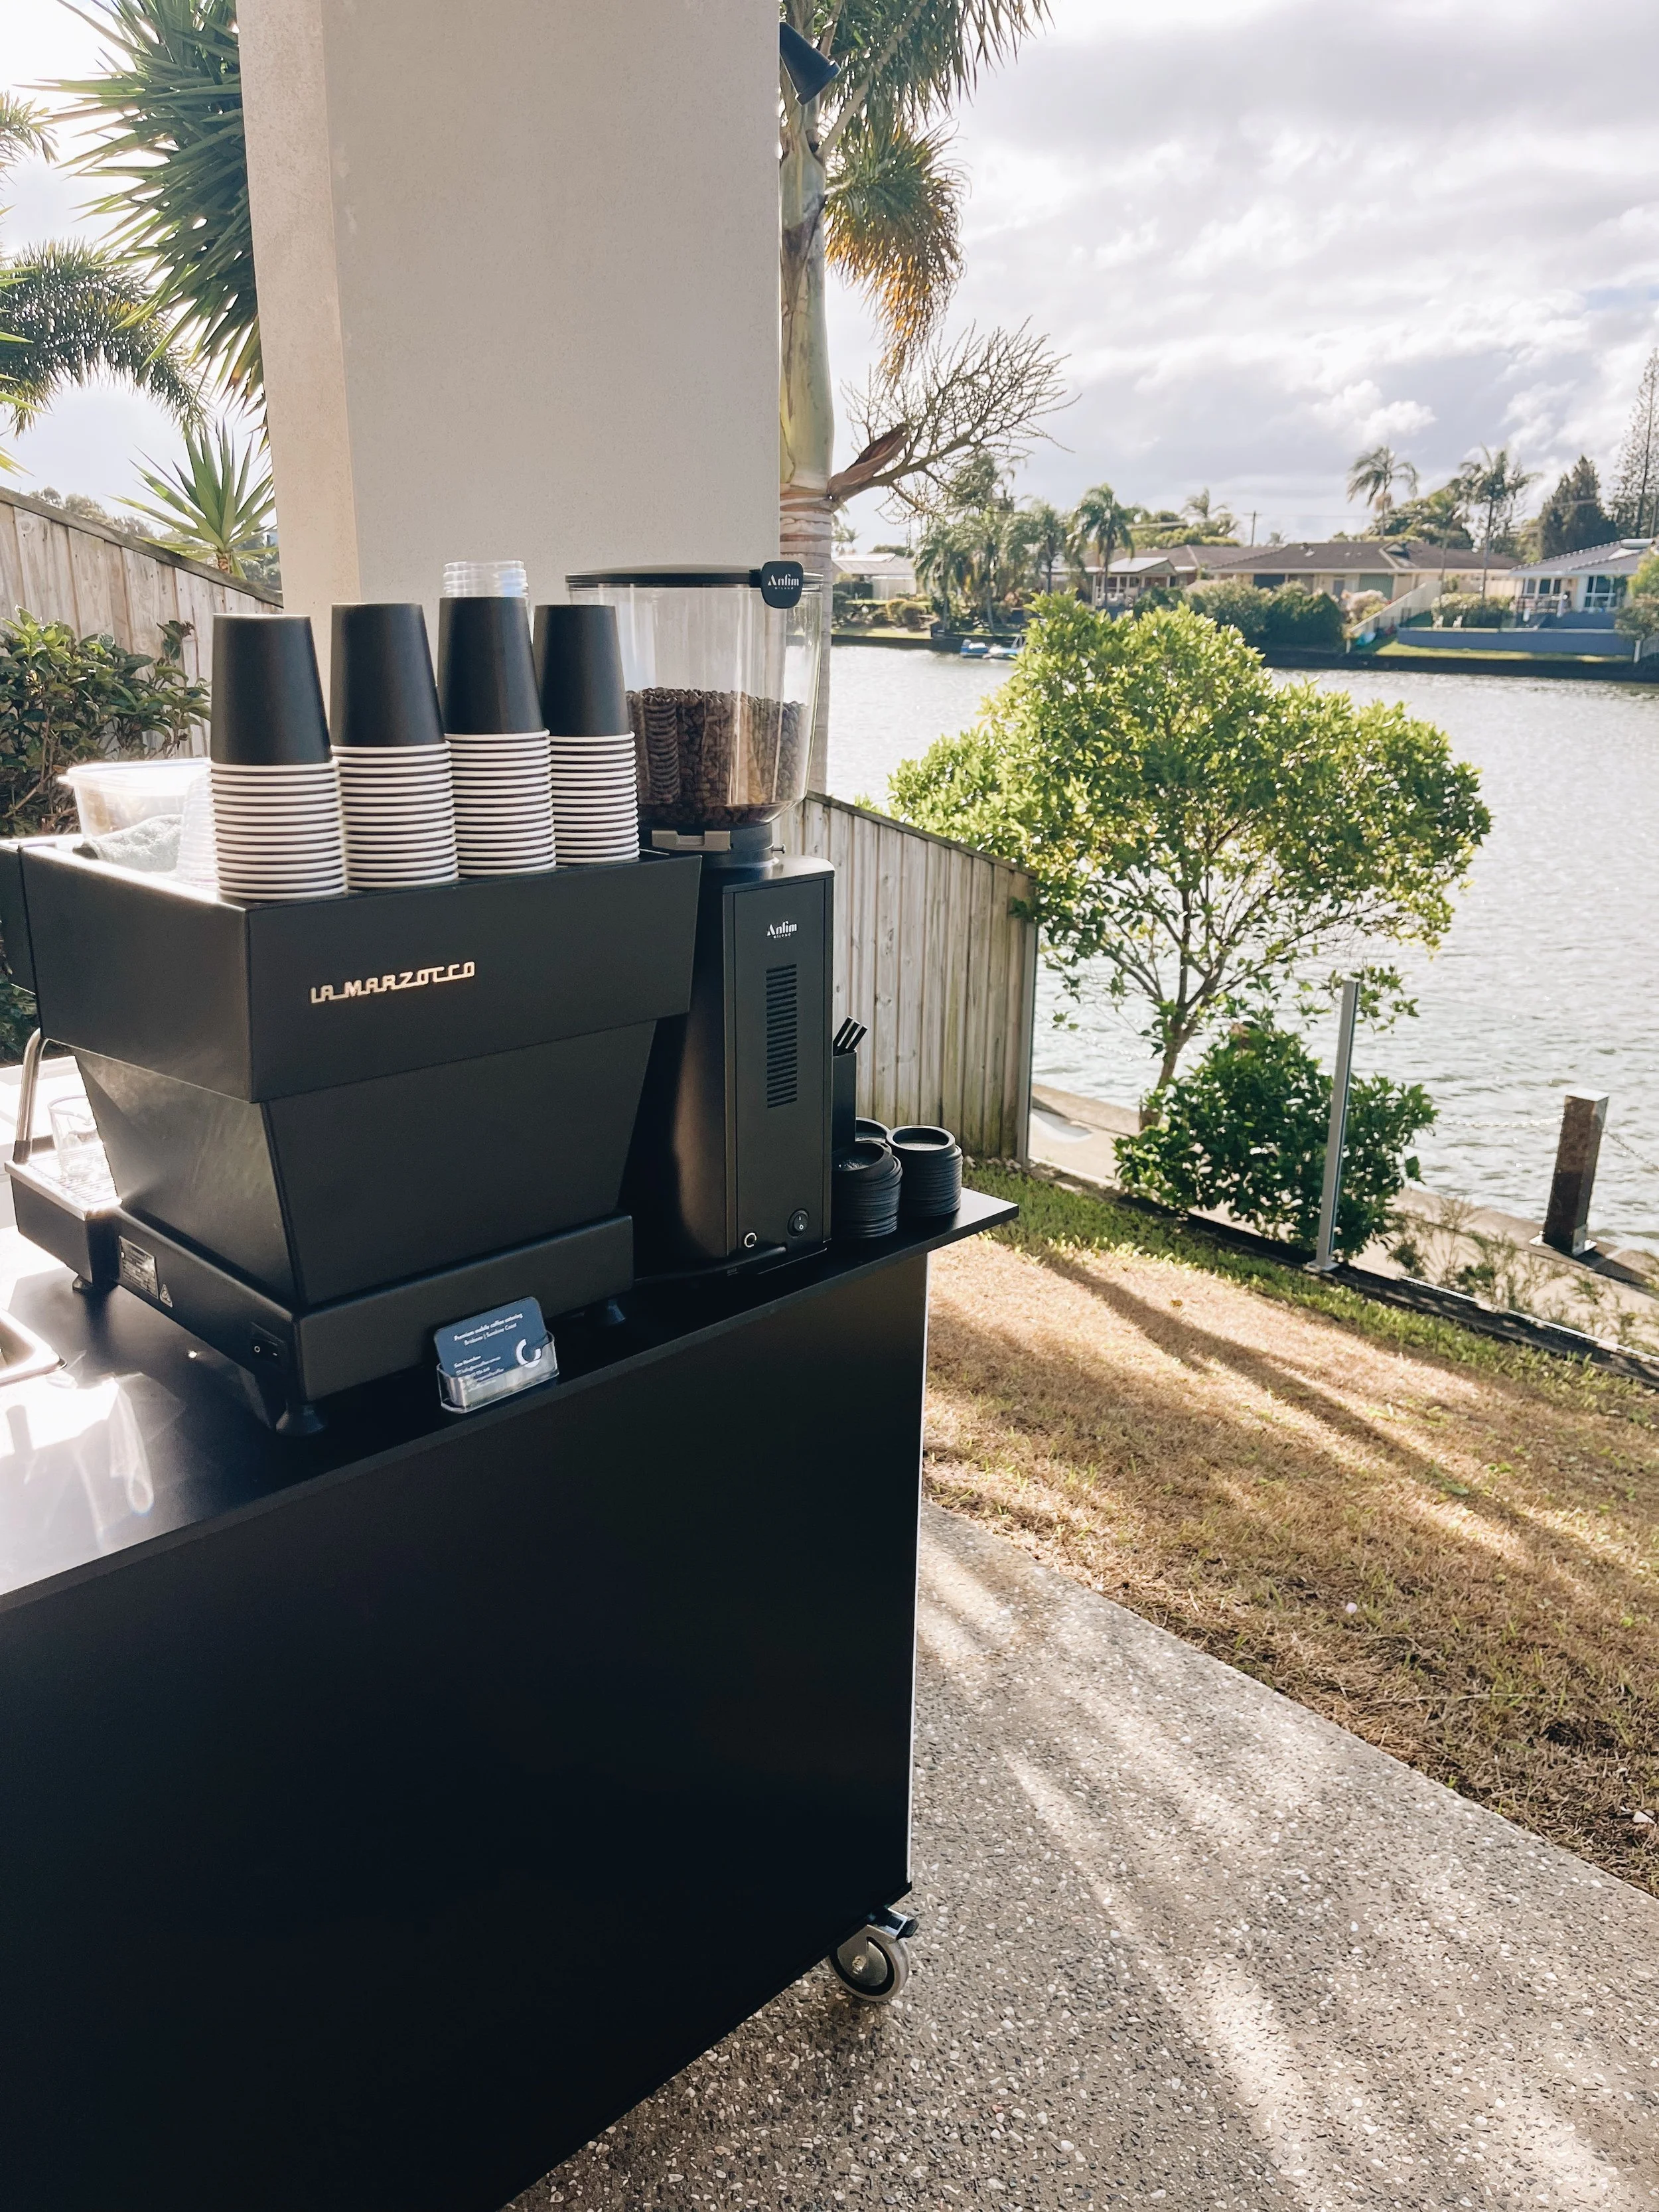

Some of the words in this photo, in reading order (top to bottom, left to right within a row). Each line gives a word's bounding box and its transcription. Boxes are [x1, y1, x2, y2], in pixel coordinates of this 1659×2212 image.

[768, 574, 799, 586] Anfim
[767, 921, 797, 936] Anfim
[311, 984, 334, 1003] LA
[344, 961, 475, 997] MARZOCCO
